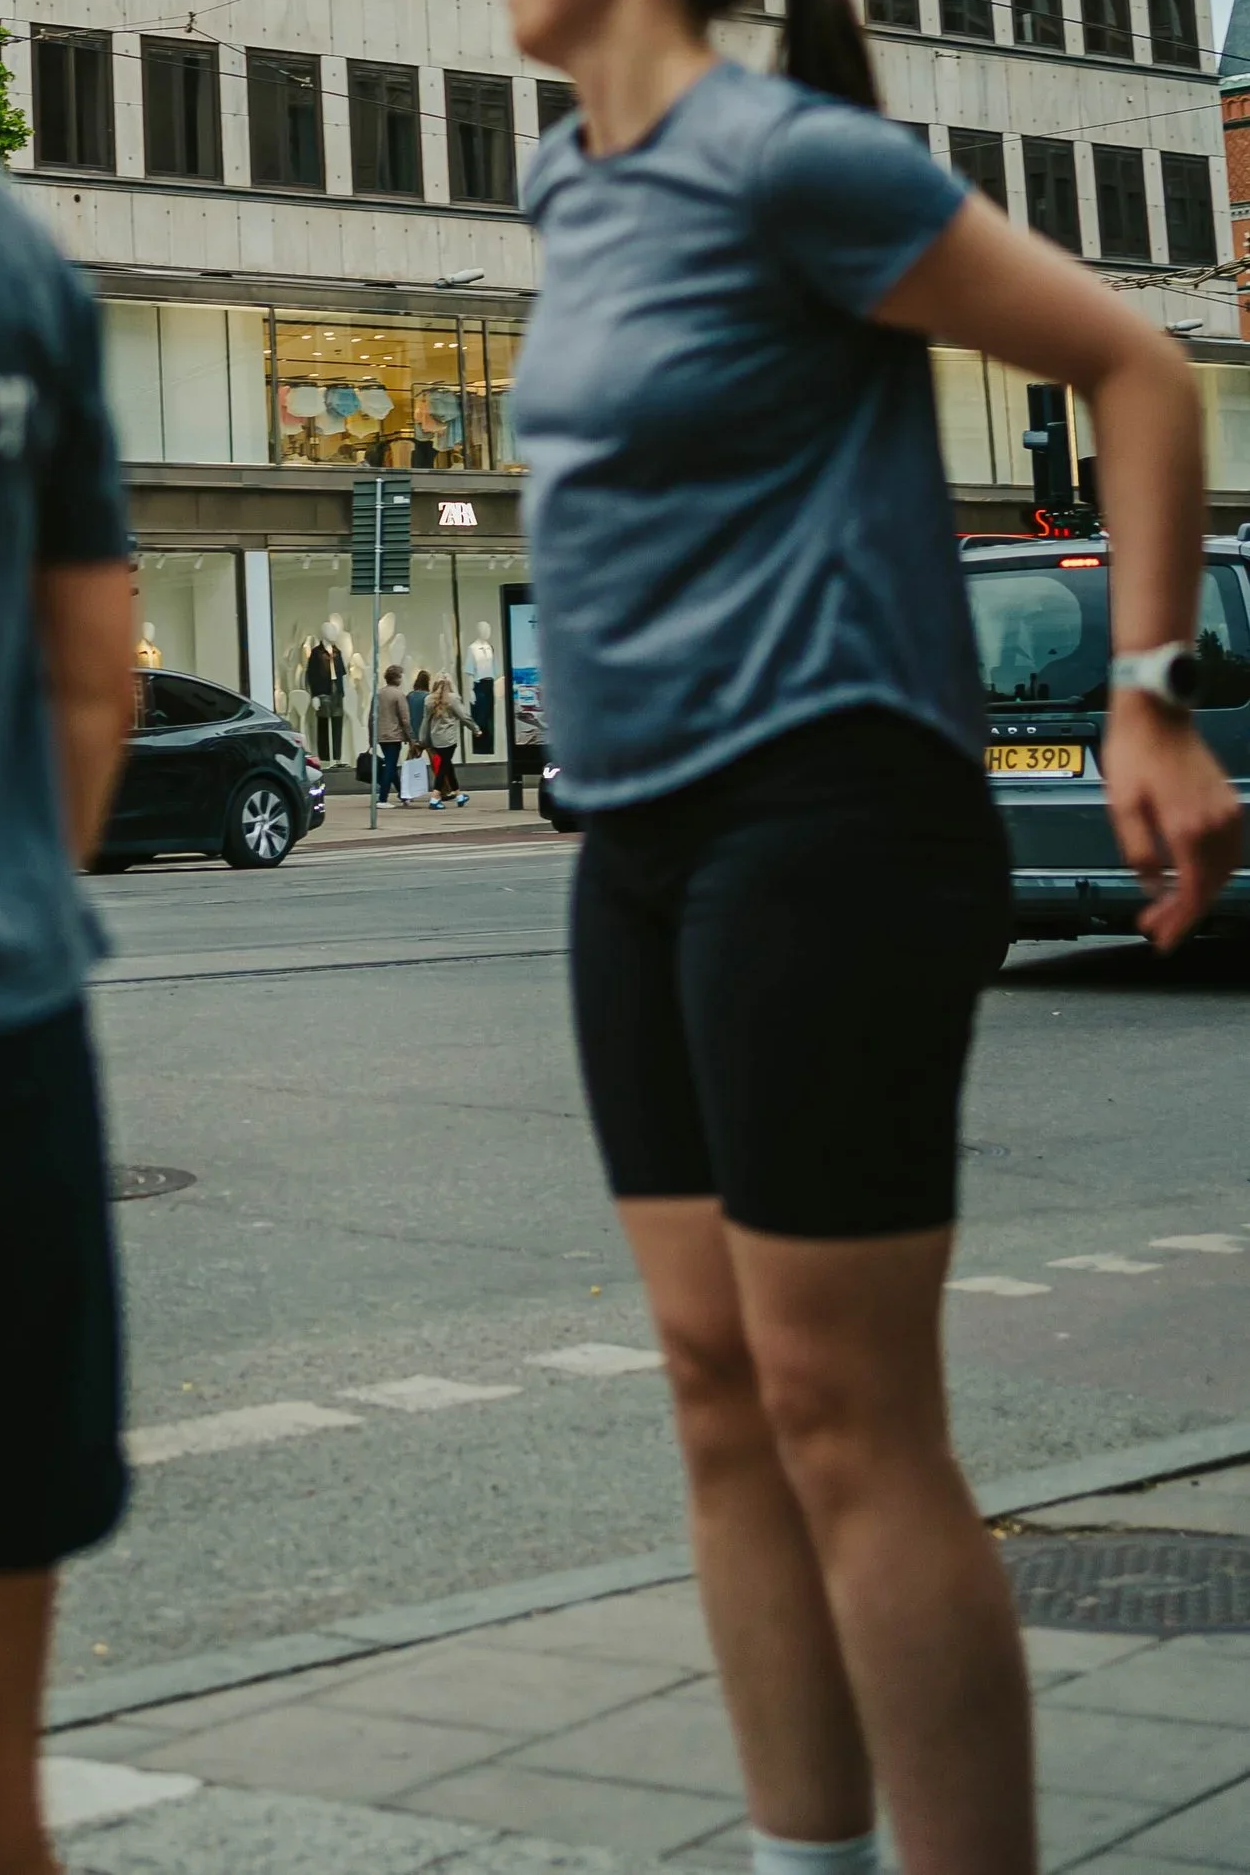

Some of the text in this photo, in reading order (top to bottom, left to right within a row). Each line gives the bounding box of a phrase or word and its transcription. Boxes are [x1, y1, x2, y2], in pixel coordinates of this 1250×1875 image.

[438, 502, 478, 525] ZARA
[984, 748, 1070, 770] HC 39D
